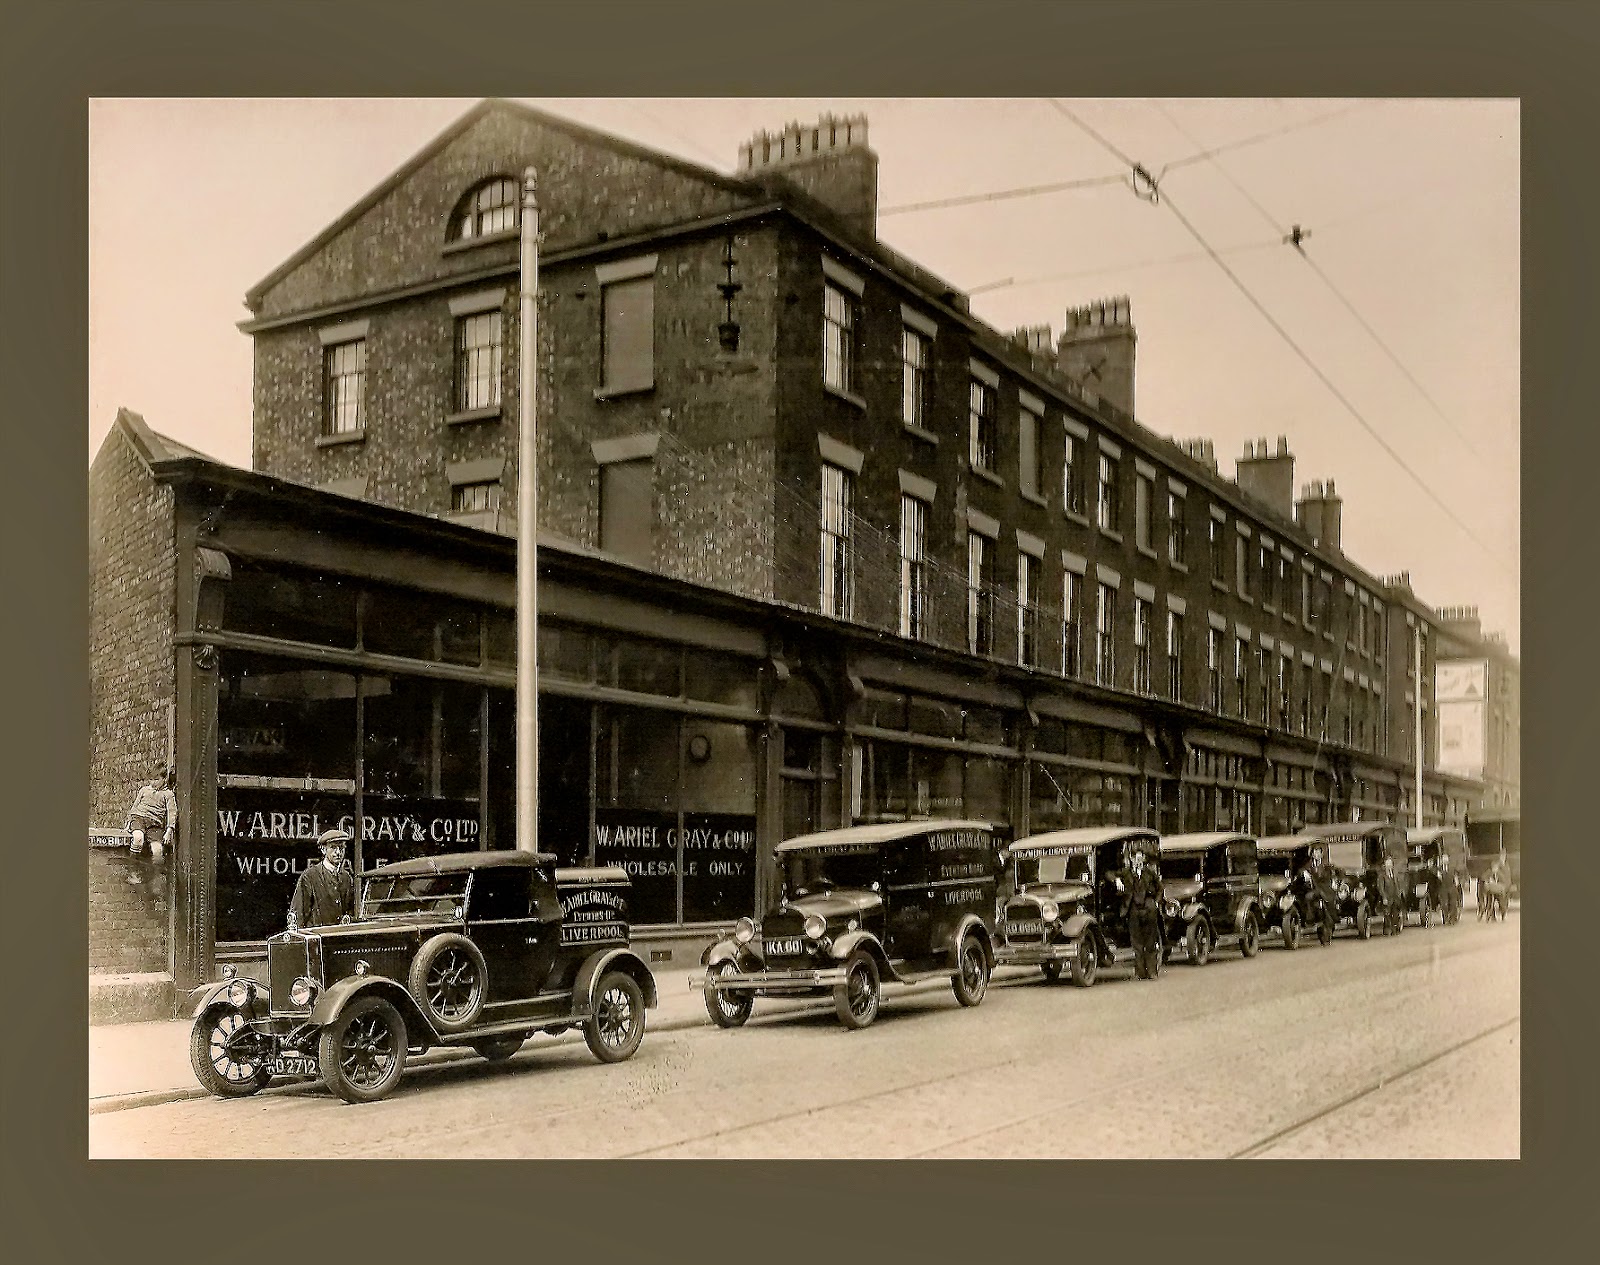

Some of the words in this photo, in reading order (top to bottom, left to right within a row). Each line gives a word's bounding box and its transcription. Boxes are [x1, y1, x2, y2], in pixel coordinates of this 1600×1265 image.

[338, 815, 409, 841] GRAY
[613, 825, 661, 849] ARIEL
[667, 828, 711, 850] GRAY
[236, 857, 388, 875] WHOLEALE
[562, 926, 624, 941] LIVERPOOL
[287, 1058, 317, 1074] 2712
